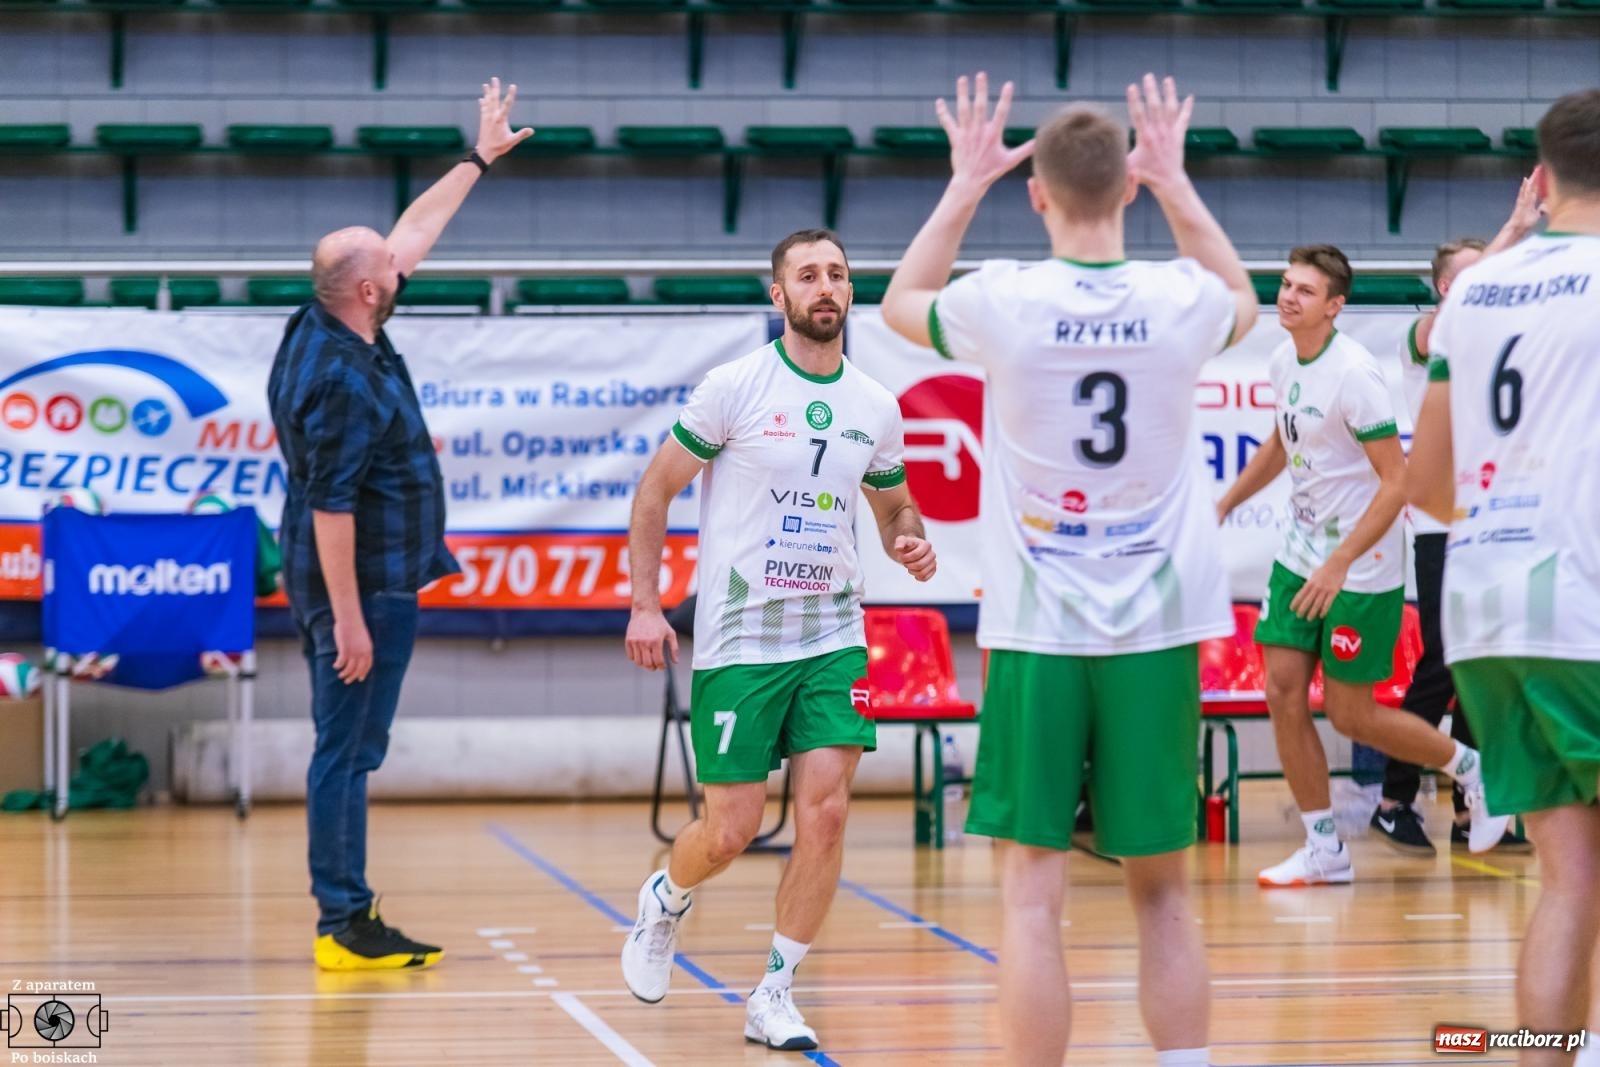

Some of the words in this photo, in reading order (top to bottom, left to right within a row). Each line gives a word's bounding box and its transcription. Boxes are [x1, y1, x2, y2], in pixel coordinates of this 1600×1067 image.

[1055, 318, 1148, 343] RZYTKI
[420, 381, 505, 407] Biura
[516, 387, 540, 405] w
[1488, 332, 1524, 436] 6
[1072, 371, 1127, 470] 3
[1284, 412, 1299, 443] 16
[452, 431, 491, 456] ul.
[502, 431, 649, 460] Opawska
[809, 438, 828, 477] 7
[451, 474, 491, 501] ul.
[771, 489, 847, 513] VISON
[88, 558, 232, 596] molten
[450, 545, 539, 597] 570
[546, 546, 607, 596] 77
[764, 560, 834, 580] PIVEXIN
[764, 577, 831, 591] TECHNOLOGY
[713, 710, 738, 755] 7
